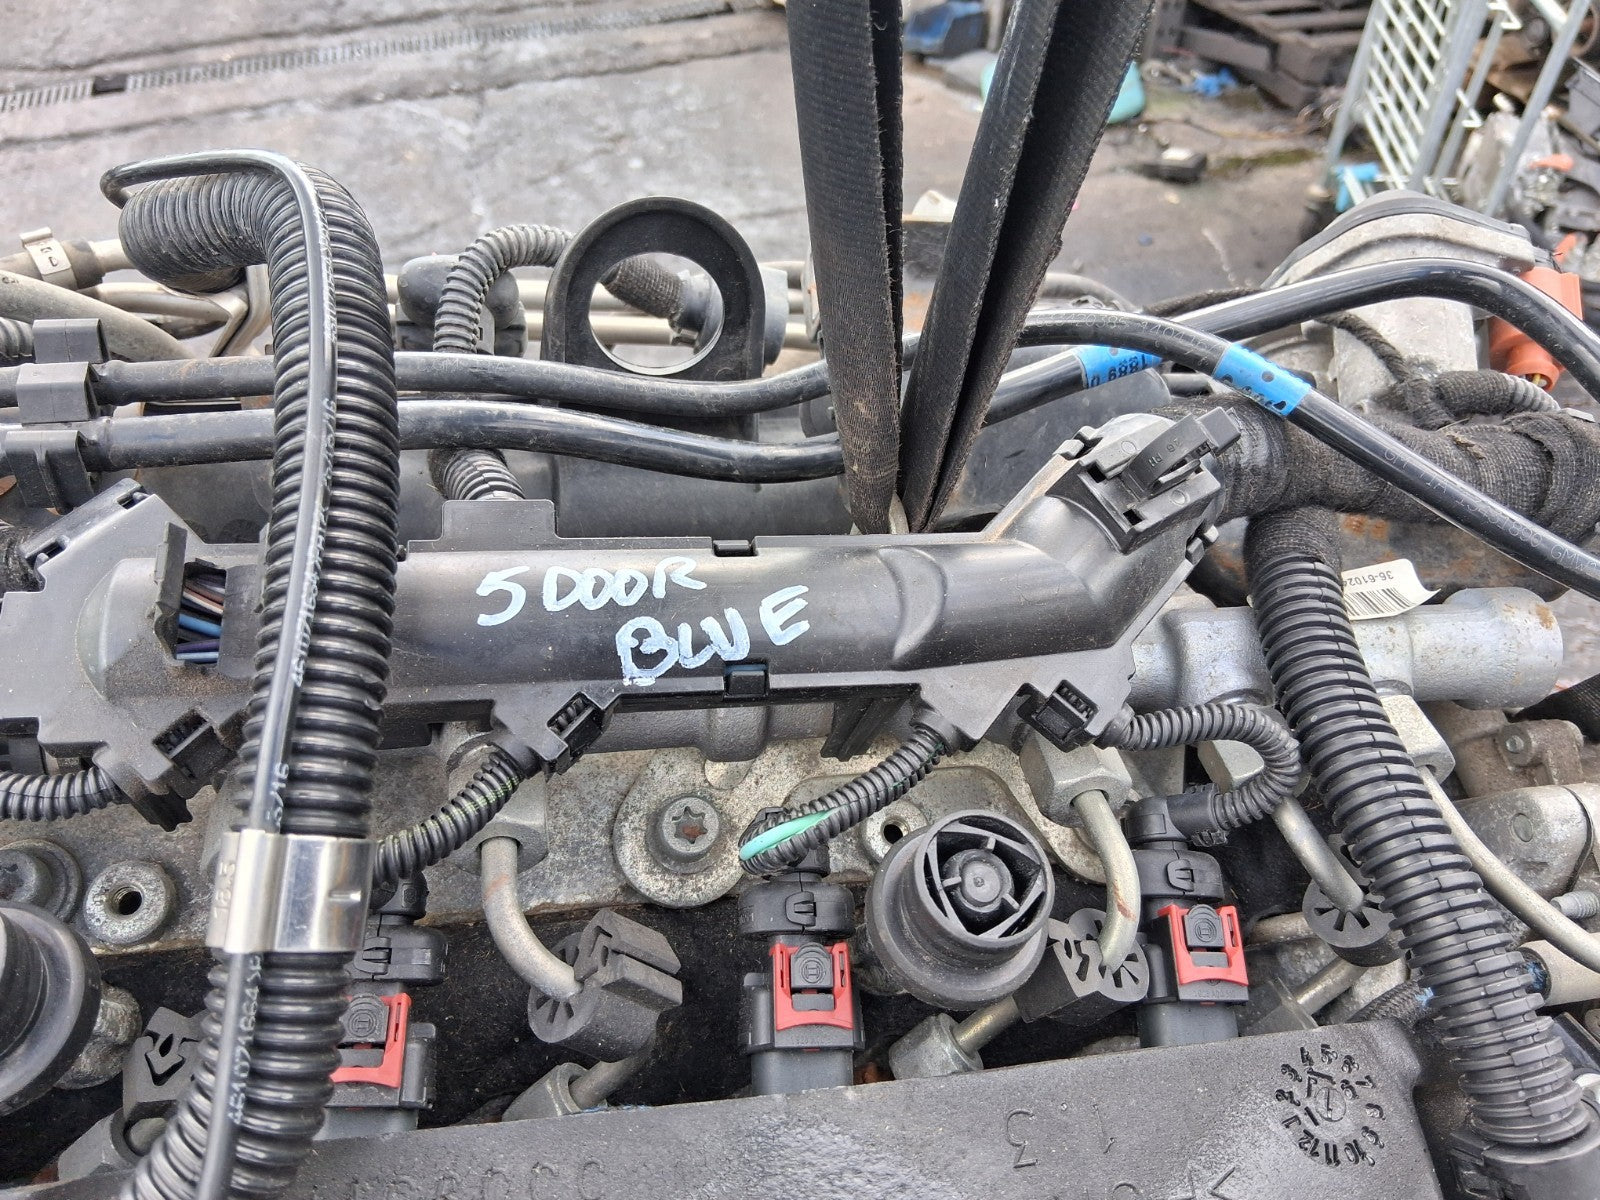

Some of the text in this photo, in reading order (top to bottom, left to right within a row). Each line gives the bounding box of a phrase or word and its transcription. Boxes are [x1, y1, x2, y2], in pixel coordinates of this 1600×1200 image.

[475, 556, 707, 627] 5 DOOR
[615, 584, 811, 687] BLUE
